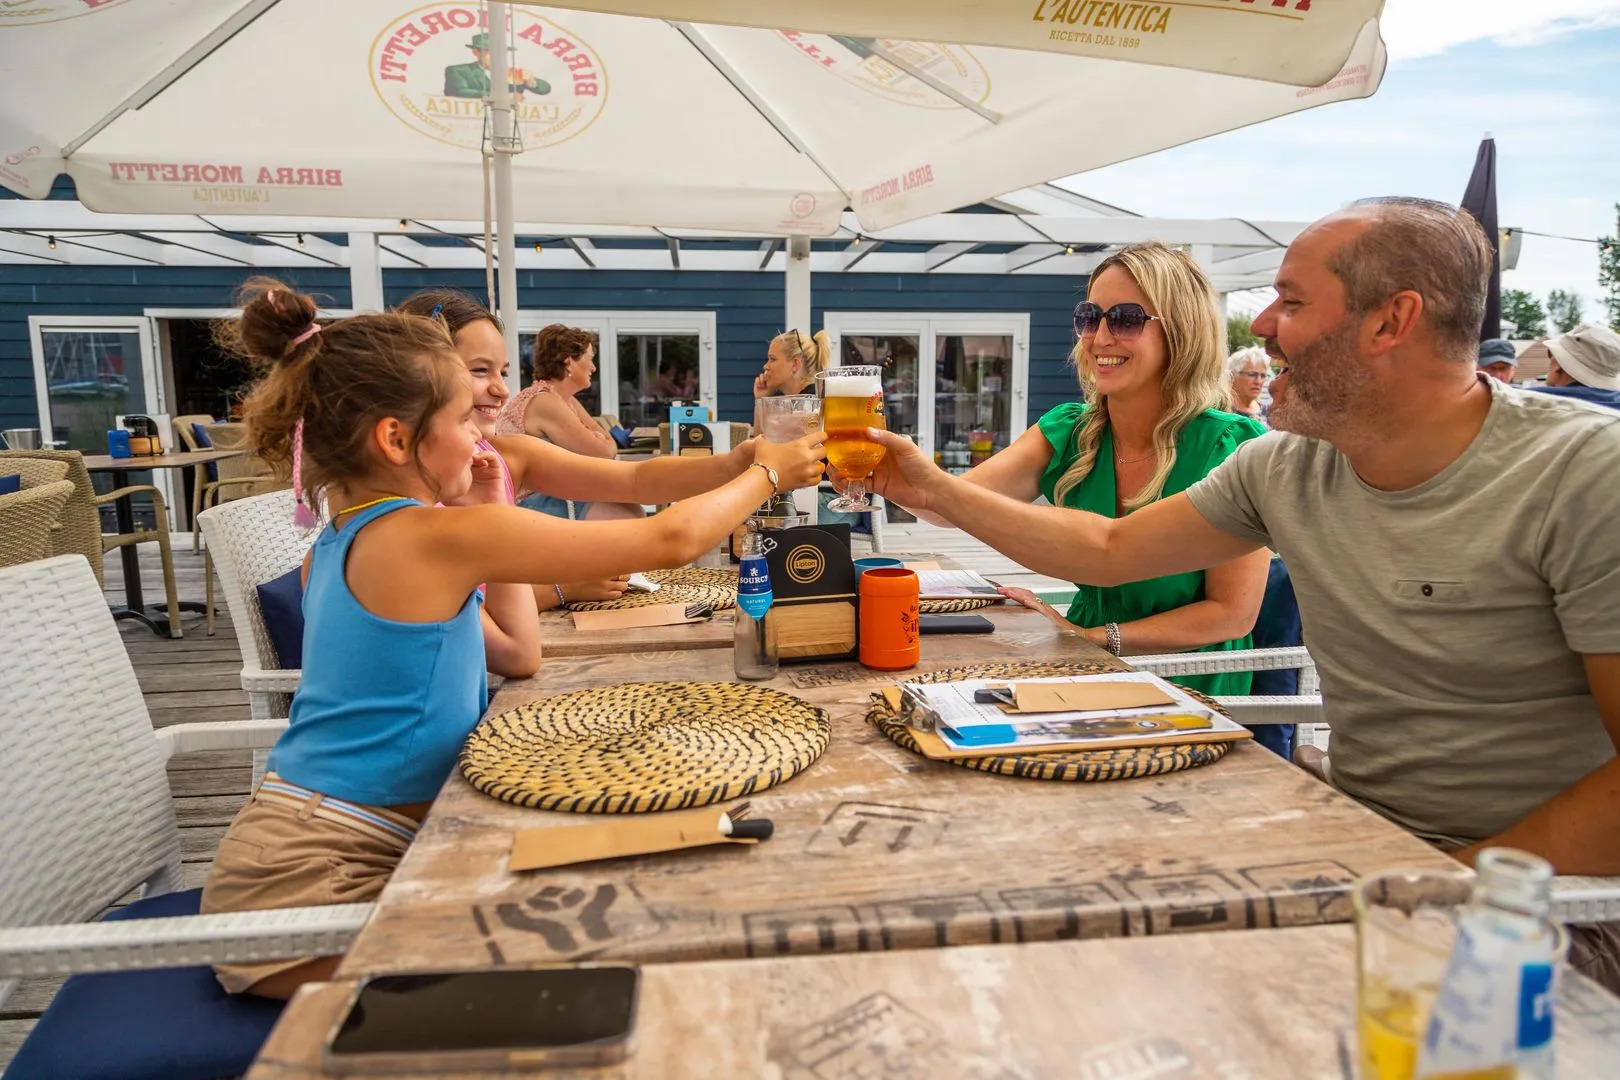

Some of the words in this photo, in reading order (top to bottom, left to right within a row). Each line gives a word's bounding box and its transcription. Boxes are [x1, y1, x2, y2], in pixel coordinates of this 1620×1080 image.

[1033, 0, 1172, 34] L'AUTENTICA
[1049, 29, 1092, 45] RICETTA
[1095, 35, 1115, 47] DAL
[795, 560, 816, 568] Lipton
[740, 574, 768, 585] SOURCY
